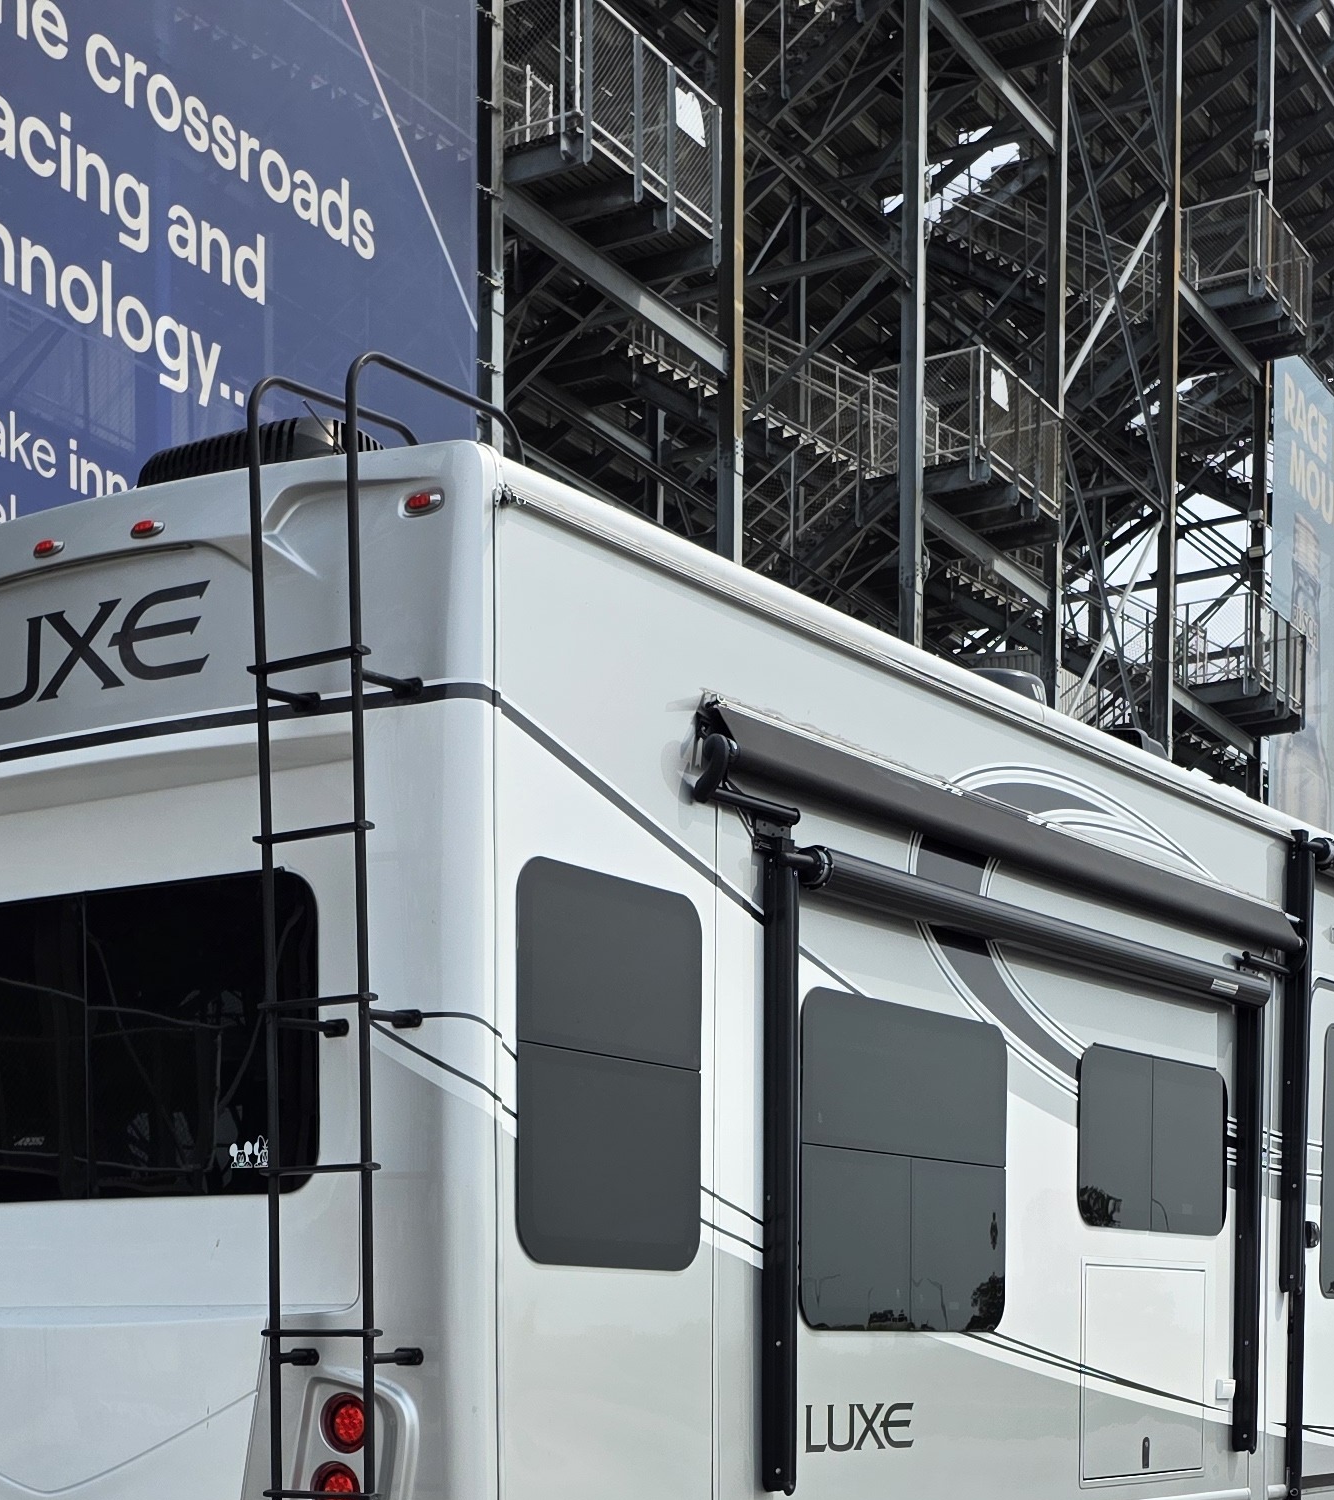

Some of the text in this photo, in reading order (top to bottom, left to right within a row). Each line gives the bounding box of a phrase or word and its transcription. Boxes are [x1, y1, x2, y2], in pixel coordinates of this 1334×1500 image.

[85, 33, 375, 260] crossroads
[168, 204, 266, 306] and
[1283, 371, 1328, 465] RACE
[69, 438, 138, 499] inn
[805, 1402, 915, 1454] LUXE
